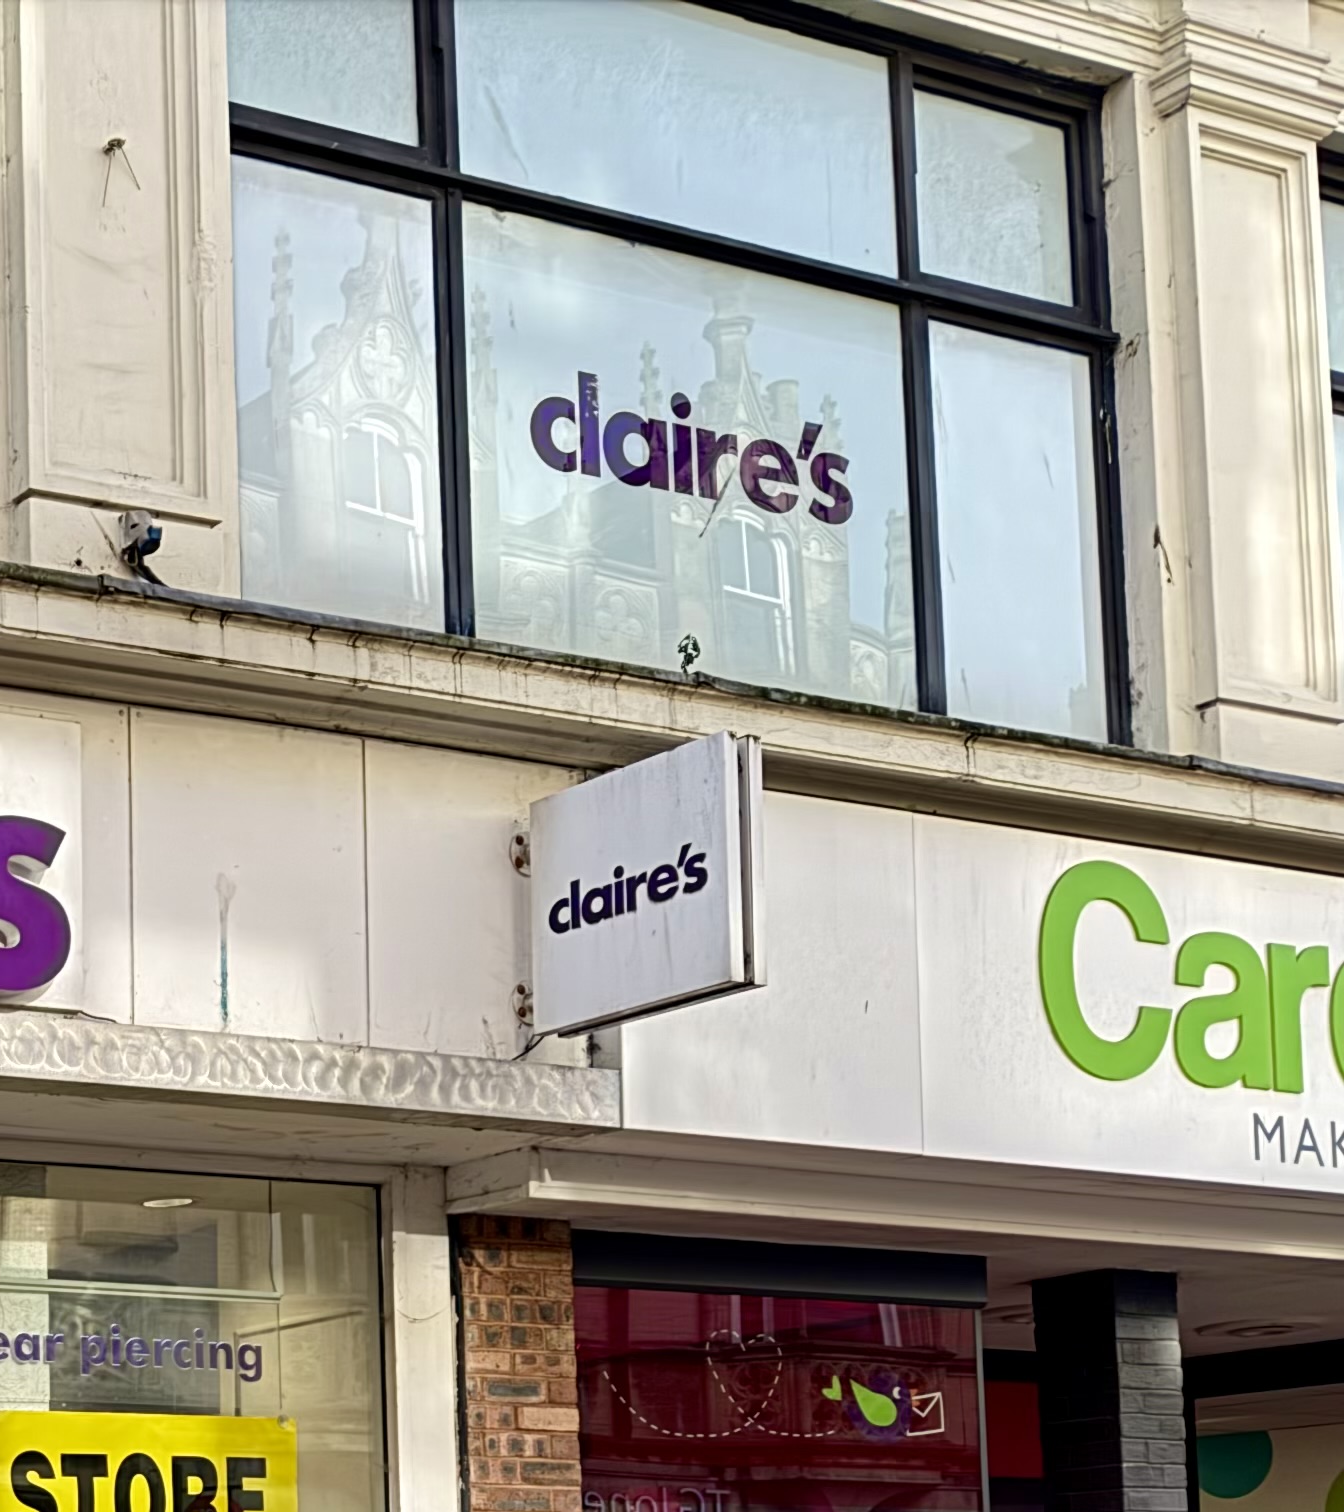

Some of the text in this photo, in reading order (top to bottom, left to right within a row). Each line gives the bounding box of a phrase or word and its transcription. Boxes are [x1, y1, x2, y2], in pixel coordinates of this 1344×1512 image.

[530, 370, 853, 525] claire's
[548, 842, 709, 935] claire's
[1038, 859, 1344, 1094] Car
[79, 1323, 264, 1382] piercing
